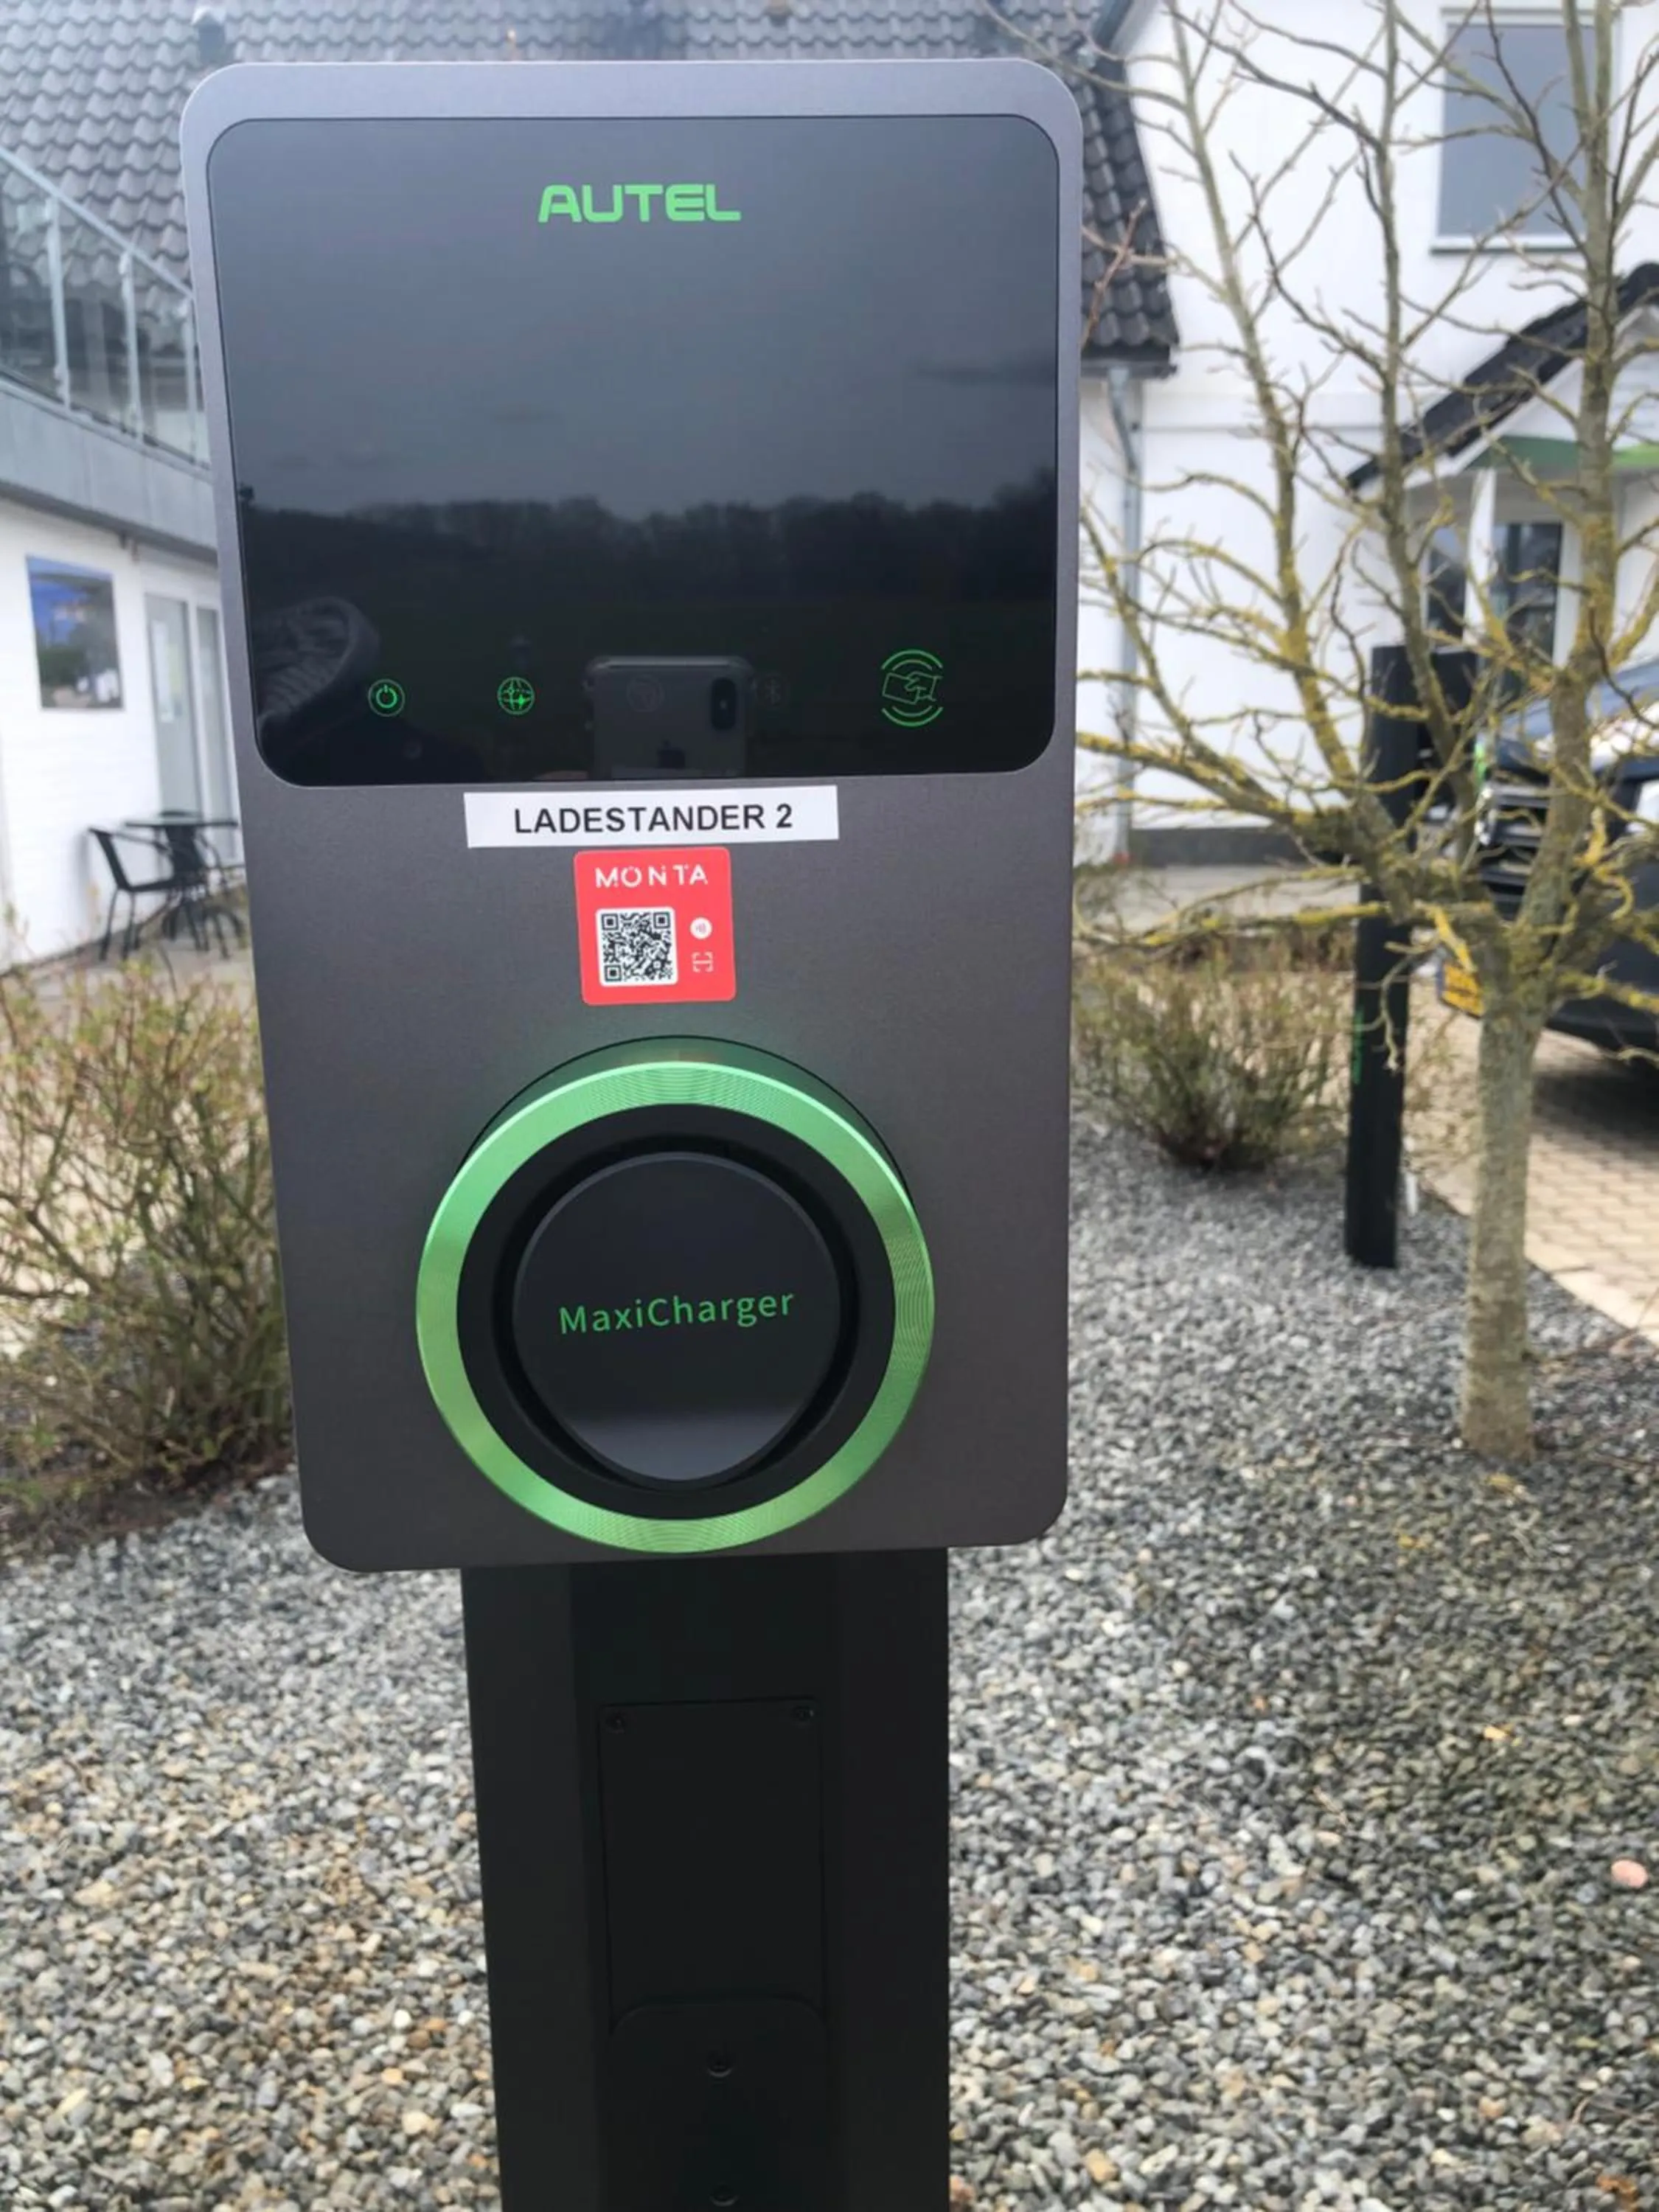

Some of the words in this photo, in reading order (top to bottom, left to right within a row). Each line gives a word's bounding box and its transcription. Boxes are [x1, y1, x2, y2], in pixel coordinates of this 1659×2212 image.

[538, 184, 741, 223] AUTEL
[514, 804, 765, 834] LADESTANDER
[775, 803, 793, 829] 2
[594, 864, 709, 888] MONTA
[559, 1293, 794, 1334] MaxiCharger
